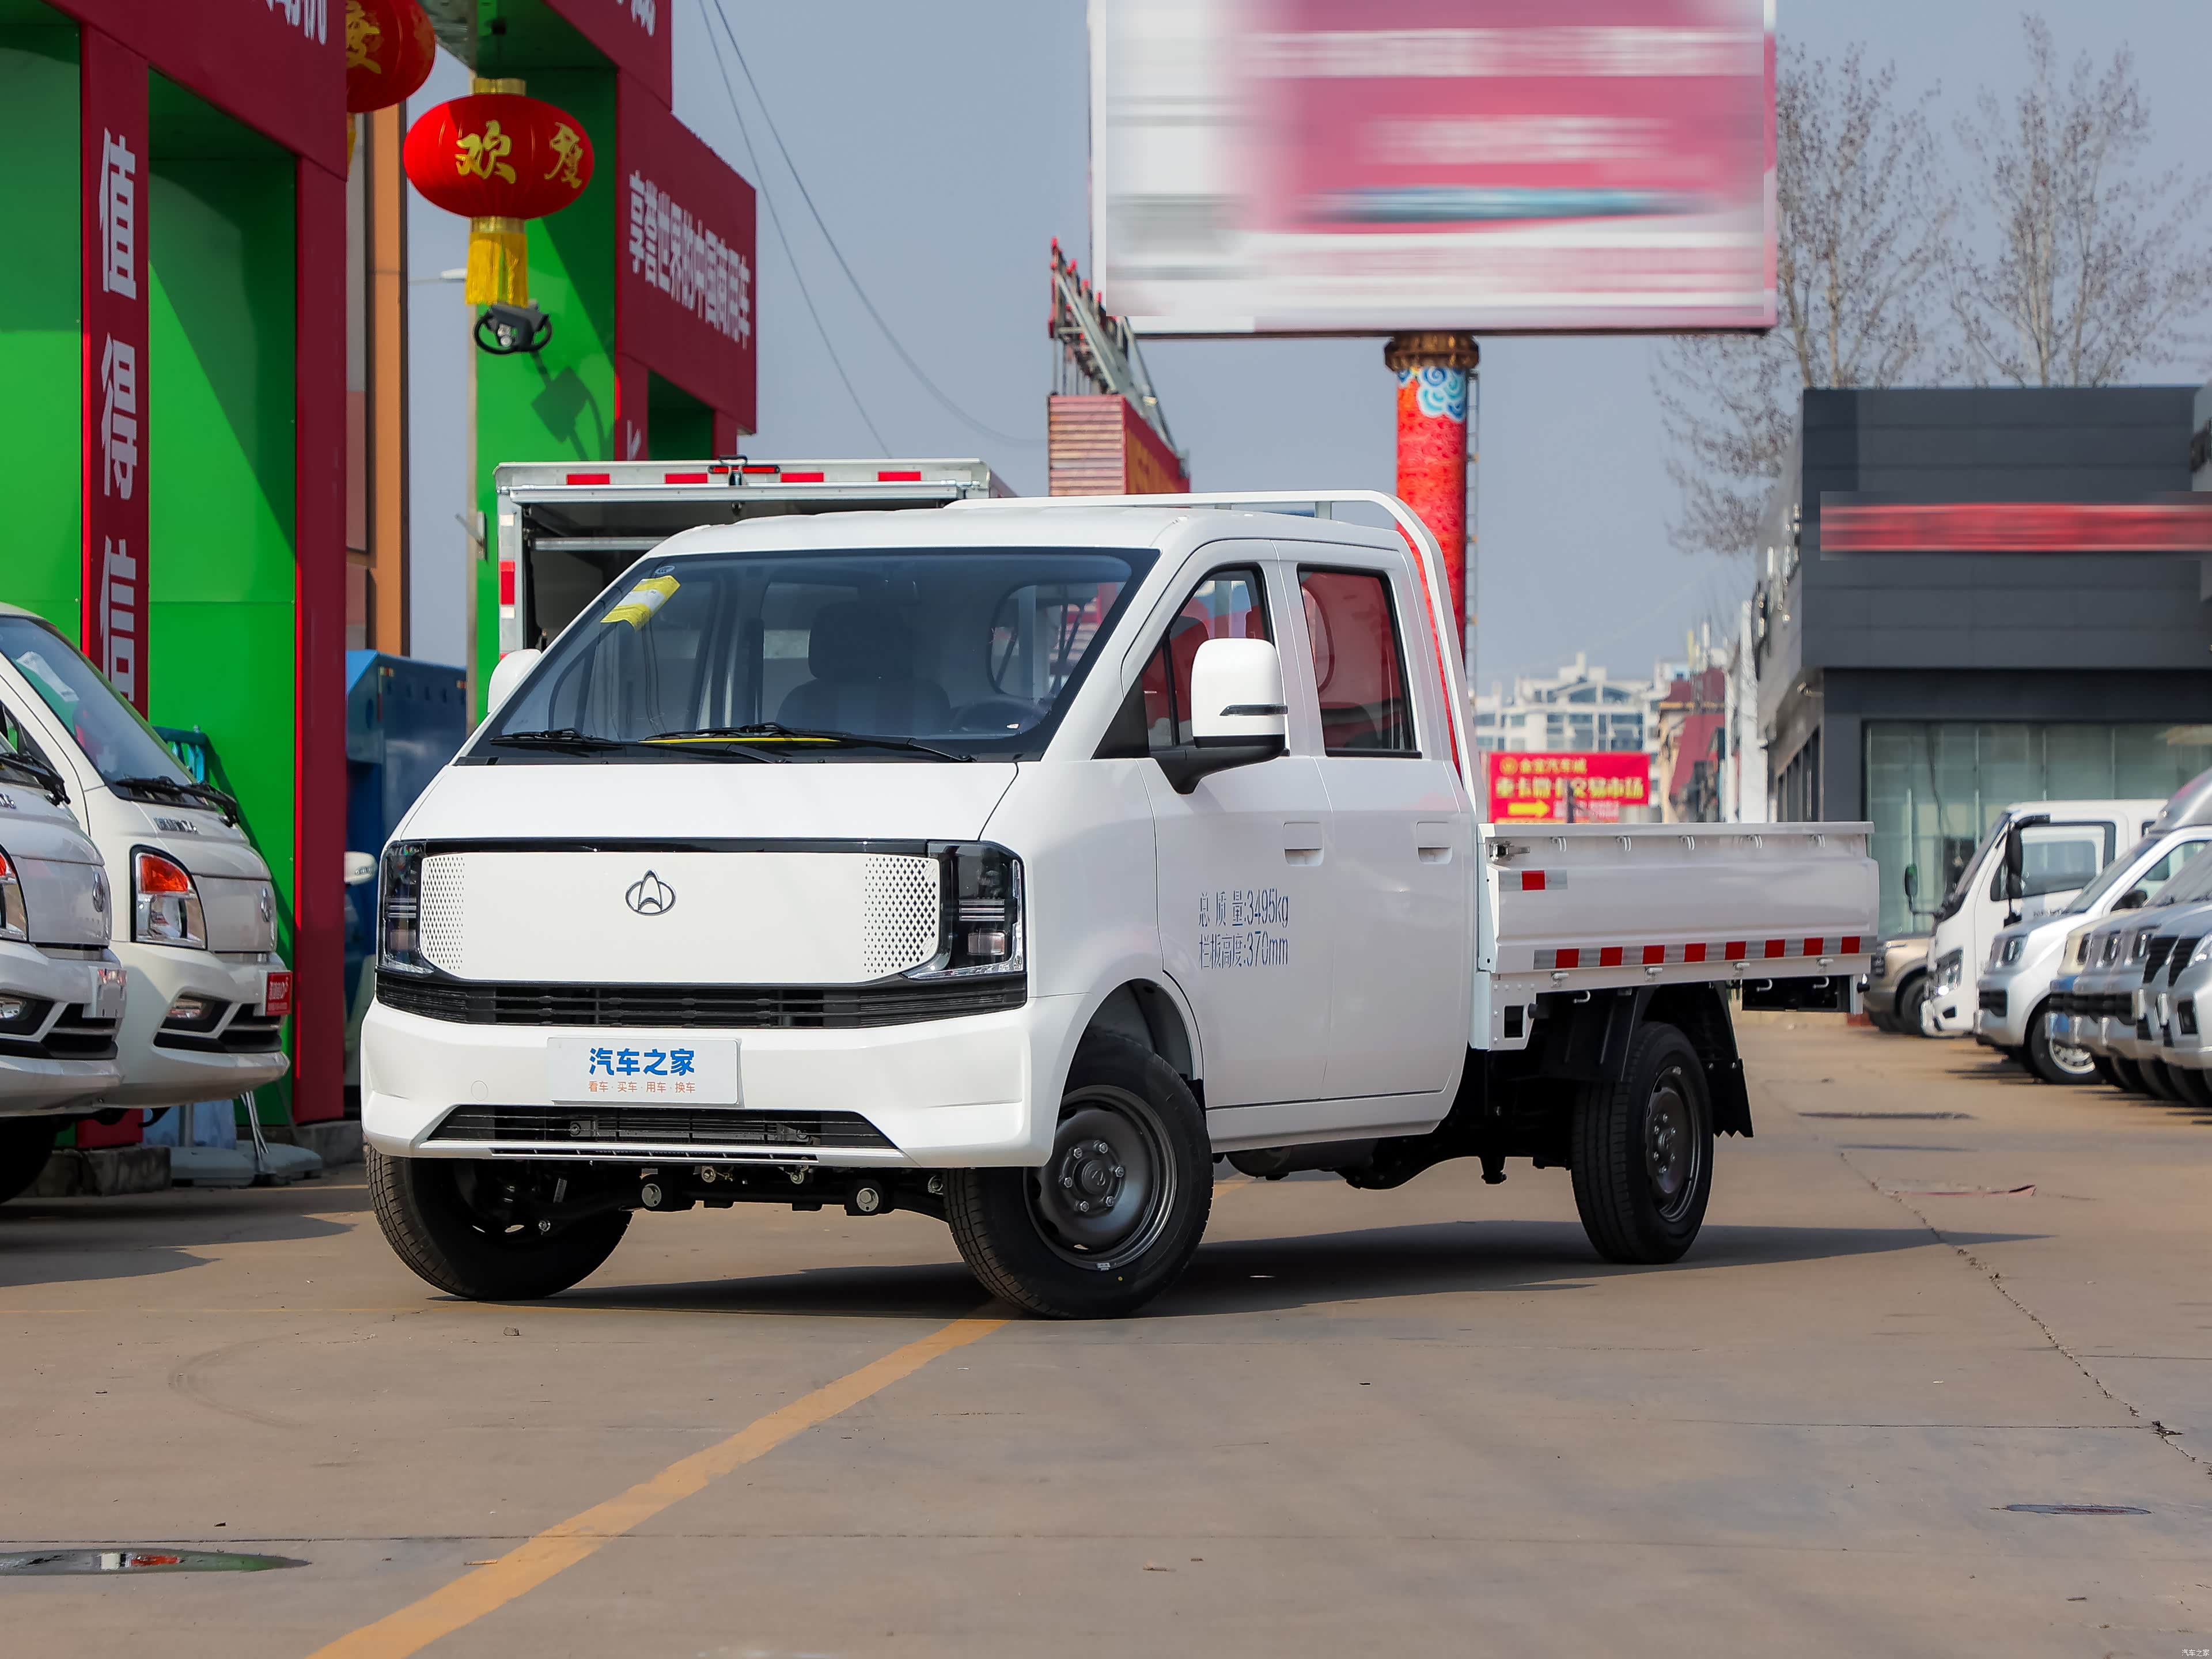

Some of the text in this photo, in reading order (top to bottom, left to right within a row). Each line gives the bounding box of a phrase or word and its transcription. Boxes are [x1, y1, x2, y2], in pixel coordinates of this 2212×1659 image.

[1198, 930, 1289, 970] 栏板高度:370mm
[588, 1047, 695, 1076] 汽车之家
